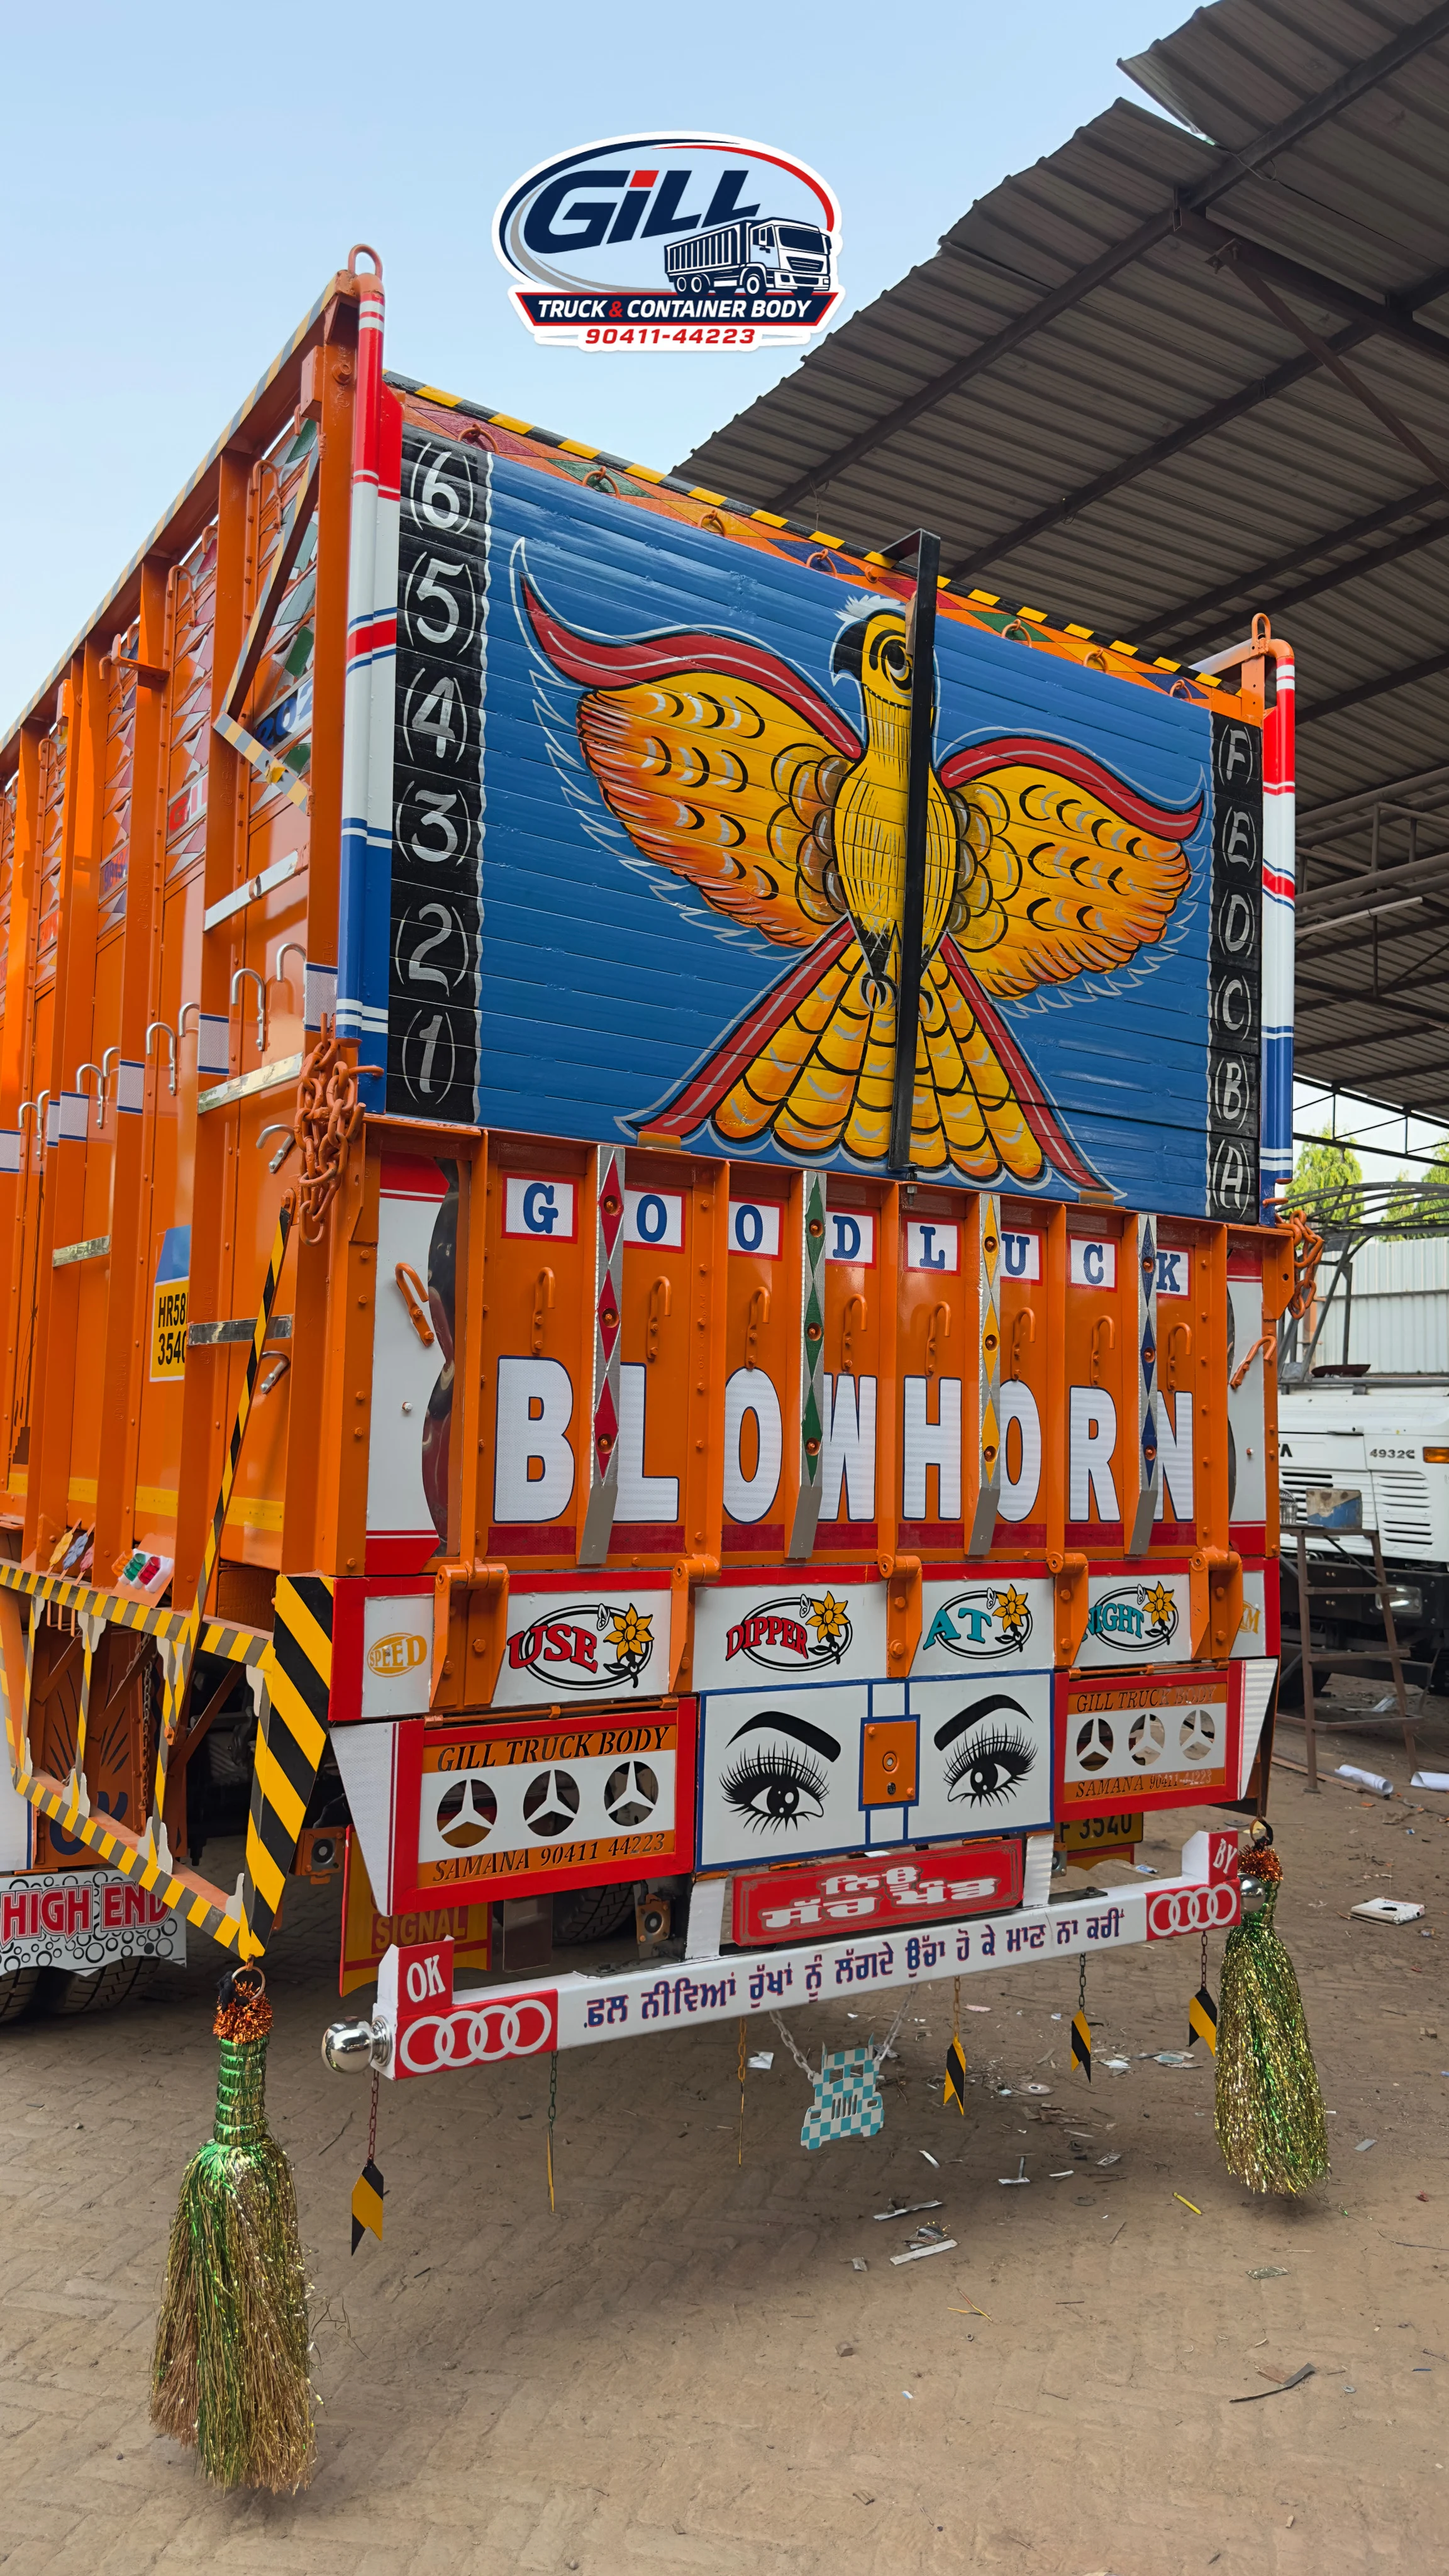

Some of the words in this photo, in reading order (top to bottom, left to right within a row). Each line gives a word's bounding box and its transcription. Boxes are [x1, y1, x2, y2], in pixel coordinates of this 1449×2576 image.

[1370, 1448, 1415, 1459] 4932C
[508, 1623, 598, 1674] USE
[725, 1616, 808, 1661] DIPPER
[923, 1607, 992, 1650] AT
[369, 1635, 427, 1667] SPEED
[1077, 1693, 1113, 1713] GILL
[1118, 1688, 1172, 1709] TRUCK
[1174, 1685, 1216, 1704] BODY
[438, 1743, 496, 1772] GILL
[506, 1733, 596, 1765] TRUCK
[597, 1726, 670, 1755] BODY
[1075, 1775, 1144, 1799] SAMANA
[432, 1850, 530, 1882] SAMANA
[541, 1841, 599, 1867] 90411
[608, 1833, 665, 1855] 44223
[1213, 1838, 1238, 1874] BY
[0, 1885, 93, 1950] HIGH
[375, 1907, 465, 1949] SIGNAL
[1057, 1919, 1079, 1945] ਨਾ
[407, 1955, 446, 2002] OK
